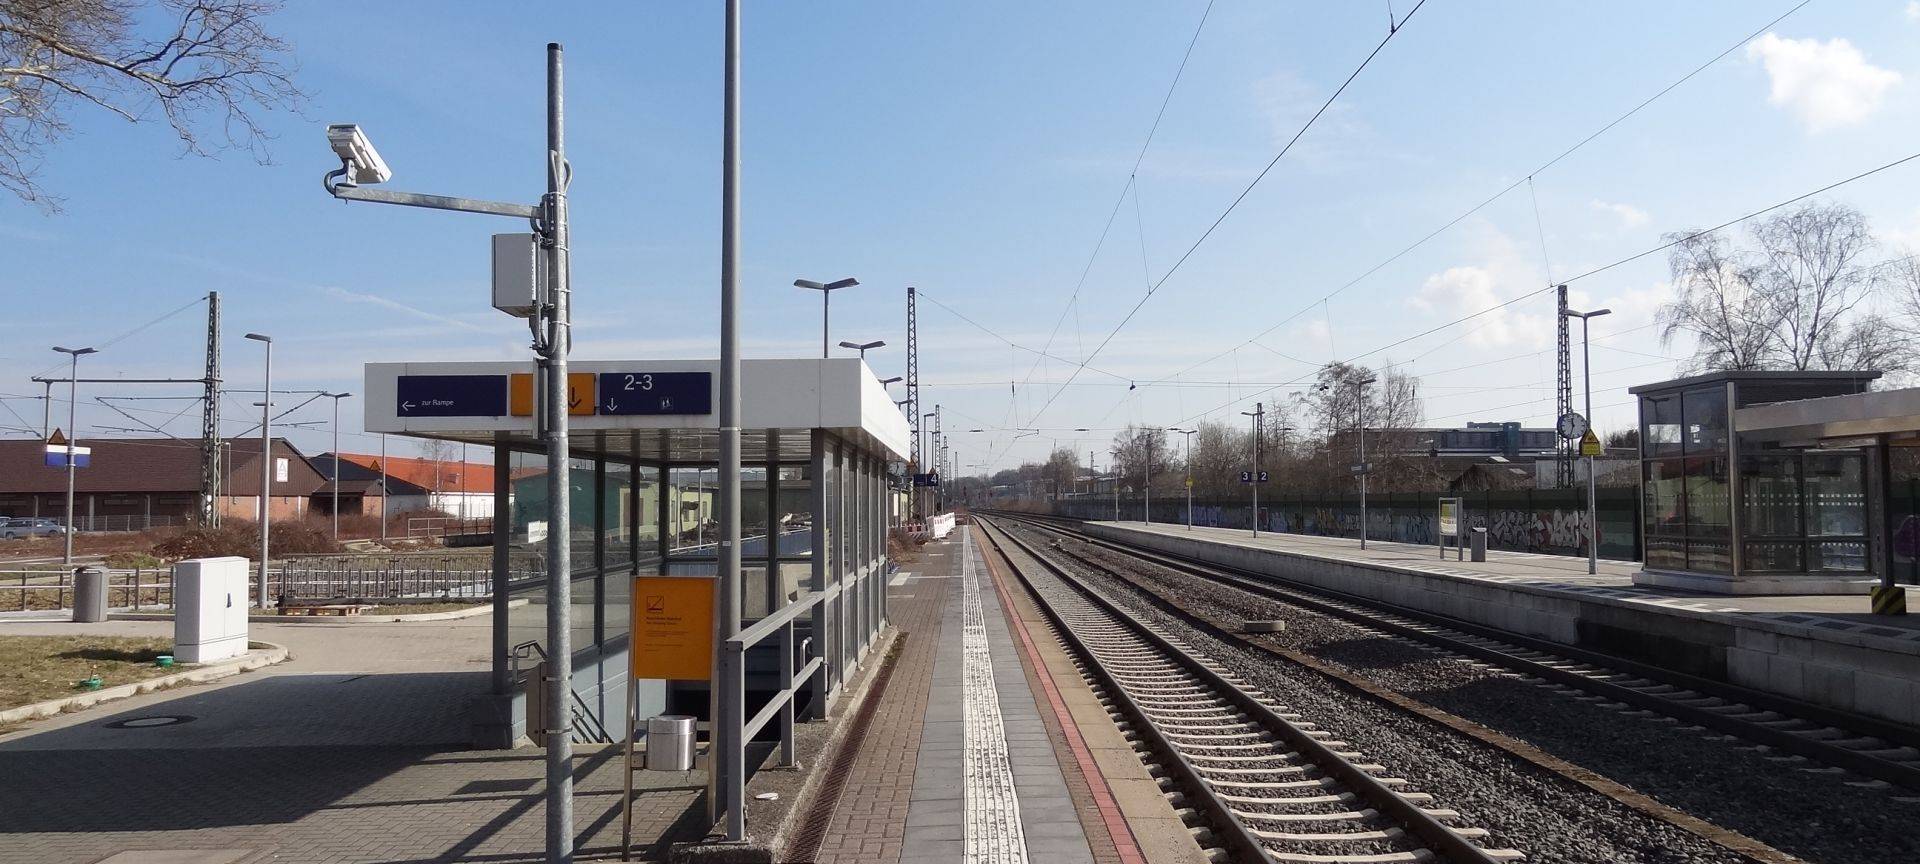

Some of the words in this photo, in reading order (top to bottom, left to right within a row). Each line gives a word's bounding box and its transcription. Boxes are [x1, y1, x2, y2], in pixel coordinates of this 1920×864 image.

[624, 374, 653, 391] 2-3
[432, 399, 454, 407] Rampe
[930, 474, 938, 484] 4
[1242, 471, 1249, 481] 3
[1261, 471, 1267, 481] 2
